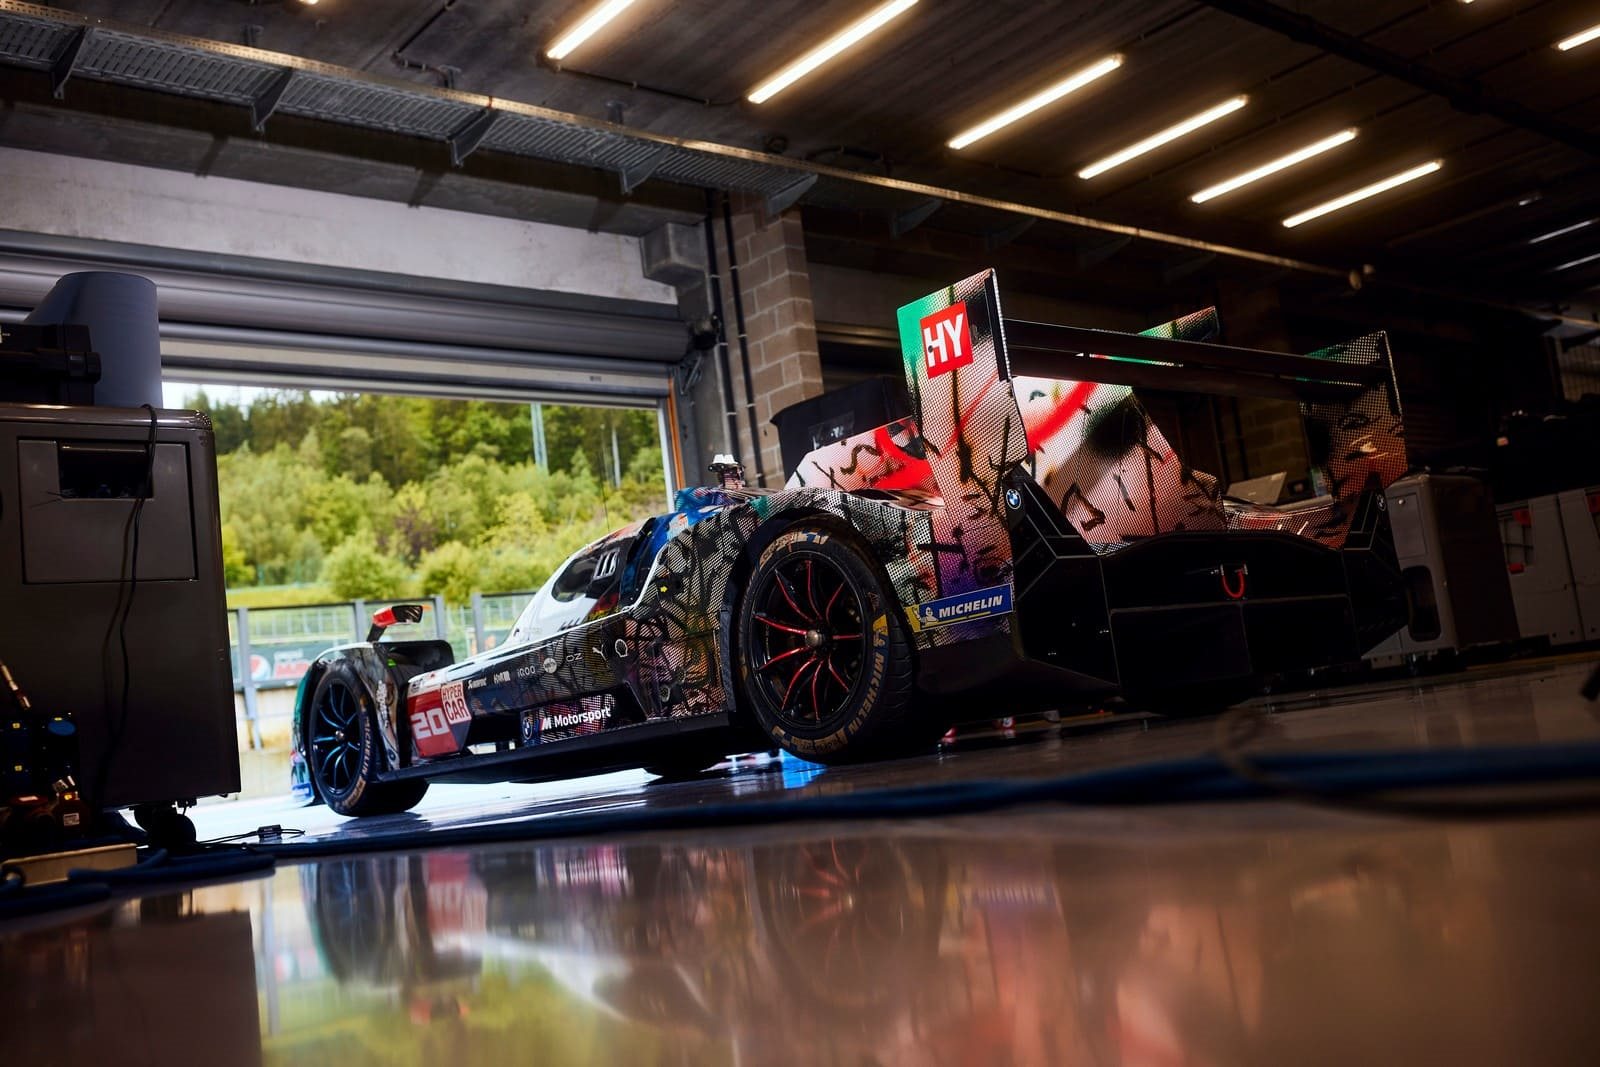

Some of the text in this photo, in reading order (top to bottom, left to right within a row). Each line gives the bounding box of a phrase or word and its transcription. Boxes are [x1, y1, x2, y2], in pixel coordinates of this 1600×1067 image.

[923, 313, 964, 368] HY
[938, 595, 1003, 618] MICHELIN
[442, 684, 463, 701] HYPER
[848, 652, 885, 735] MICHELIN
[444, 698, 470, 721] CAR
[554, 706, 612, 728] Motorsport
[410, 707, 450, 740] 20
